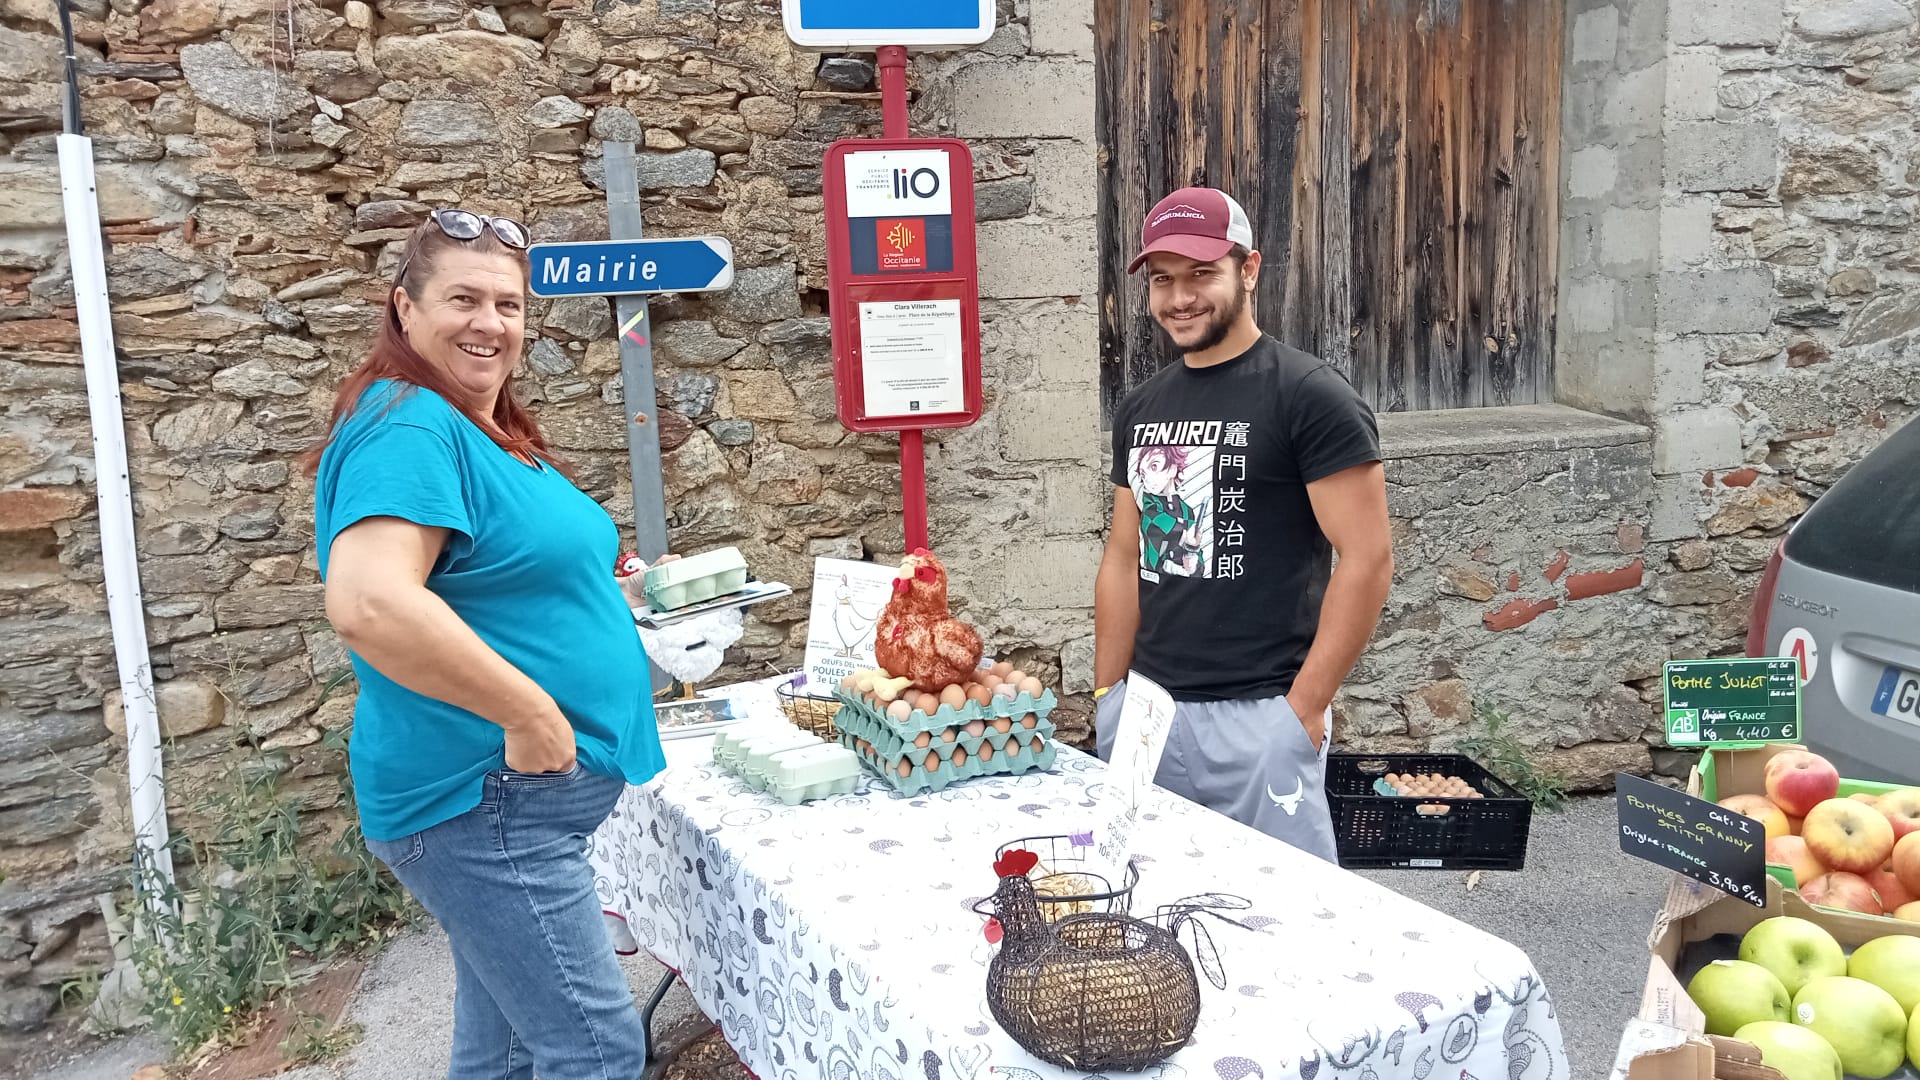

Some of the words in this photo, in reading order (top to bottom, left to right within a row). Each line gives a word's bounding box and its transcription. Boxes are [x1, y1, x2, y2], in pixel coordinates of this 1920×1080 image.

[883, 257, 921, 265] Occitanie
[542, 254, 658, 284] Mairie
[1133, 420, 1223, 446] TANJIRO
[1778, 593, 1839, 619] PEUGEOT
[813, 665, 846, 677] POULES
[821, 658, 843, 667] OEUFS
[844, 661, 856, 669] DEL
[1671, 674, 1713, 689] POMME
[1879, 691, 1888, 701] F
[1896, 679, 1920, 719] G
[1702, 709, 1727, 724] Origine
[1728, 710, 1767, 721] FRANCE
[1671, 716, 1695, 733] AB
[1781, 724, 1793, 738] €
[1626, 794, 1686, 824] POMMES
[1695, 822, 1753, 853] GRANNY
